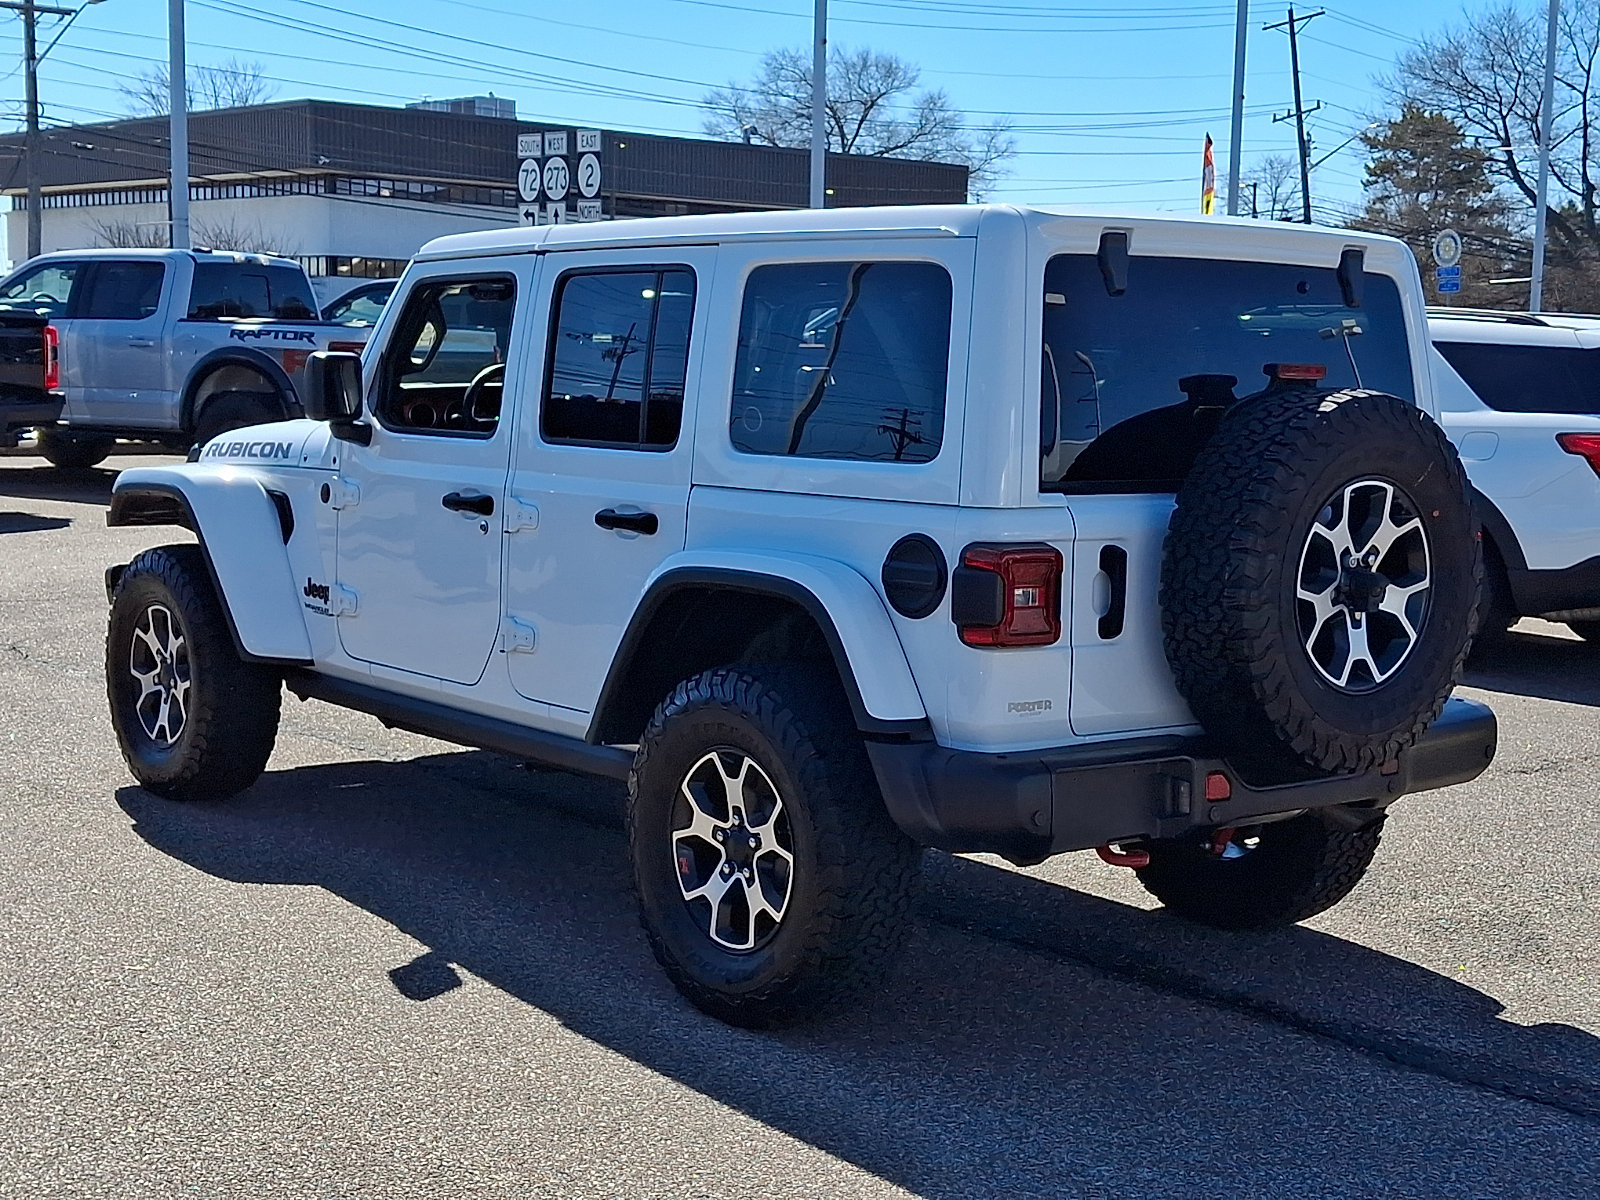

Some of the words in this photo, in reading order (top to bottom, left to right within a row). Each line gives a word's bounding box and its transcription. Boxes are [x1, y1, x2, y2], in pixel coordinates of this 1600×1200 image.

[519, 139, 540, 153] SOUTH
[547, 137, 564, 151] WEST
[581, 134, 597, 148] EAST
[521, 168, 538, 192] 72
[546, 166, 568, 191] 273
[585, 163, 595, 188] 2
[579, 205, 600, 219] NORTH
[229, 329, 317, 346] RAPTOR
[205, 441, 293, 459] RUBICON
[303, 576, 330, 606] Jeep
[1007, 699, 1052, 713] PORTER
